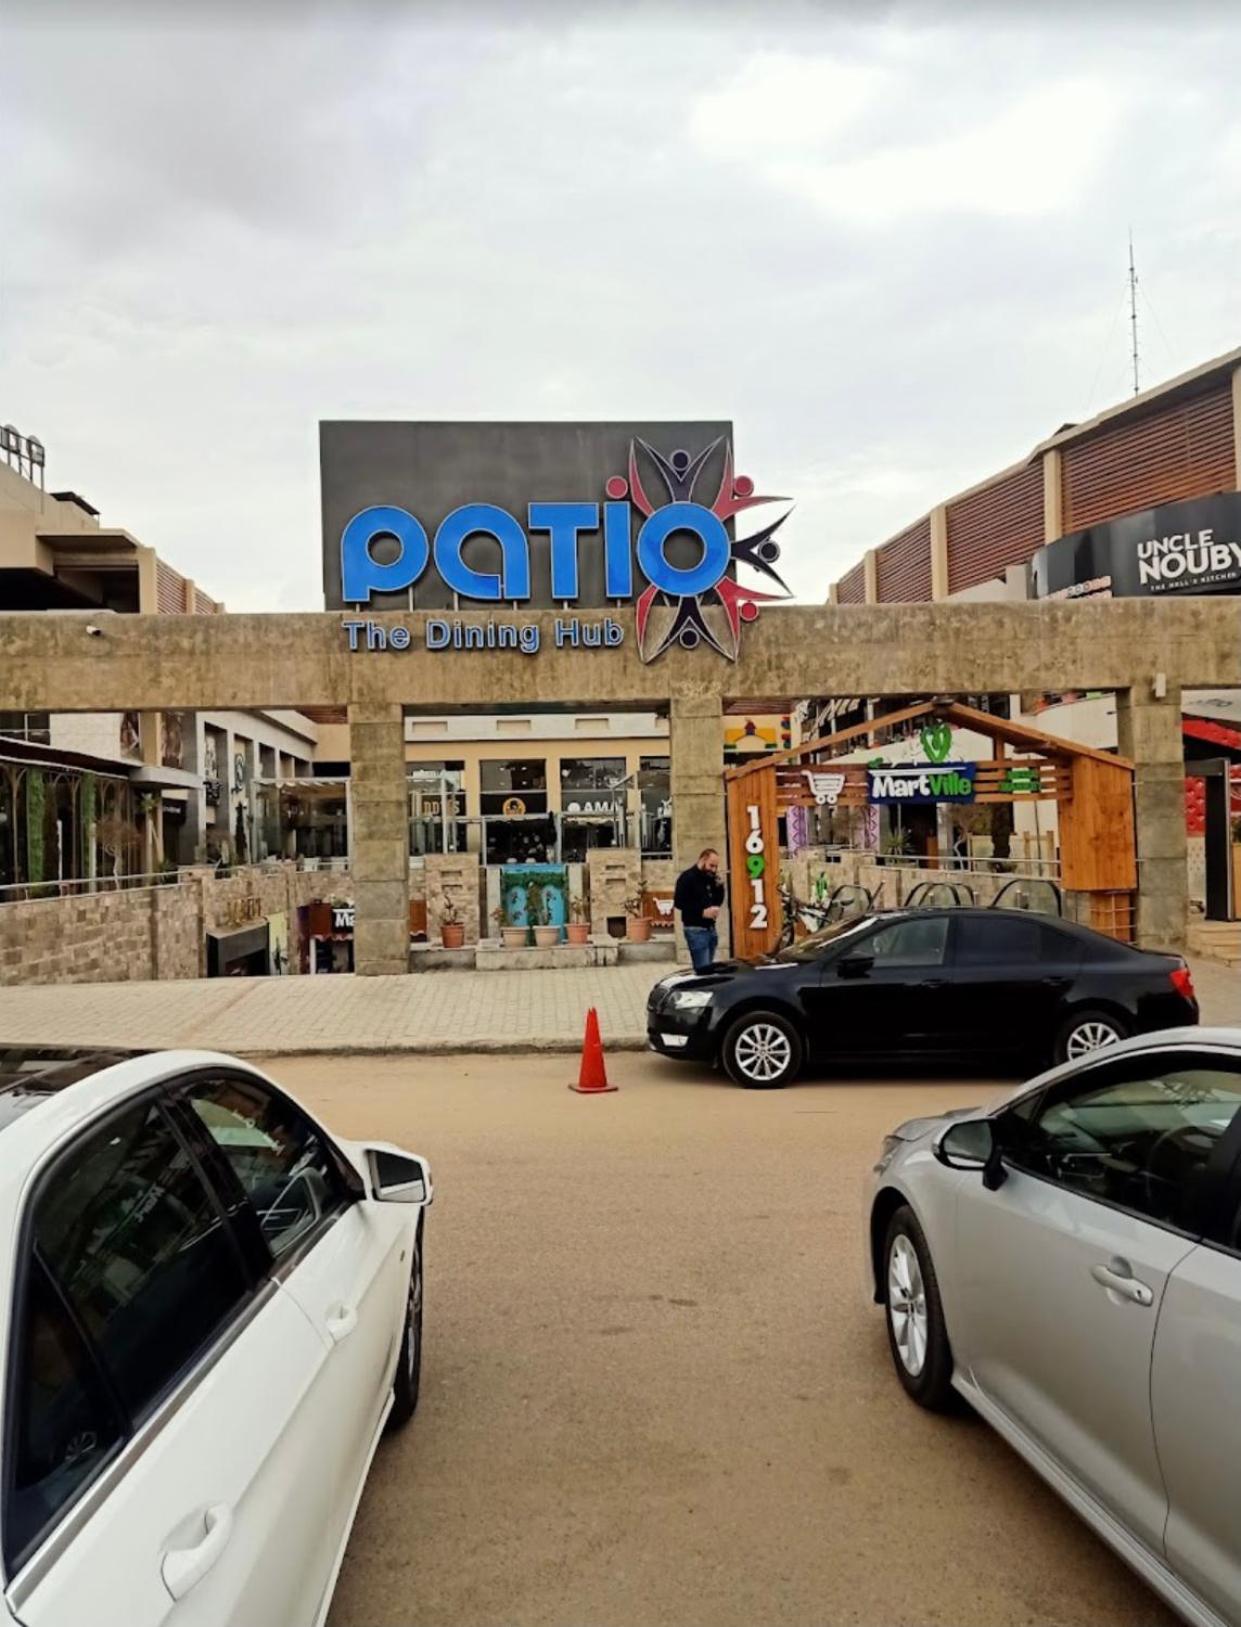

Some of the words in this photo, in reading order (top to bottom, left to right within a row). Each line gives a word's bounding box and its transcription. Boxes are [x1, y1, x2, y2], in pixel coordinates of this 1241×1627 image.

[1137, 528, 1214, 559] UNCLE
[342, 619, 411, 650] The
[425, 618, 540, 655] Dining
[555, 617, 625, 648] Hub
[745, 804, 768, 929] 16912
